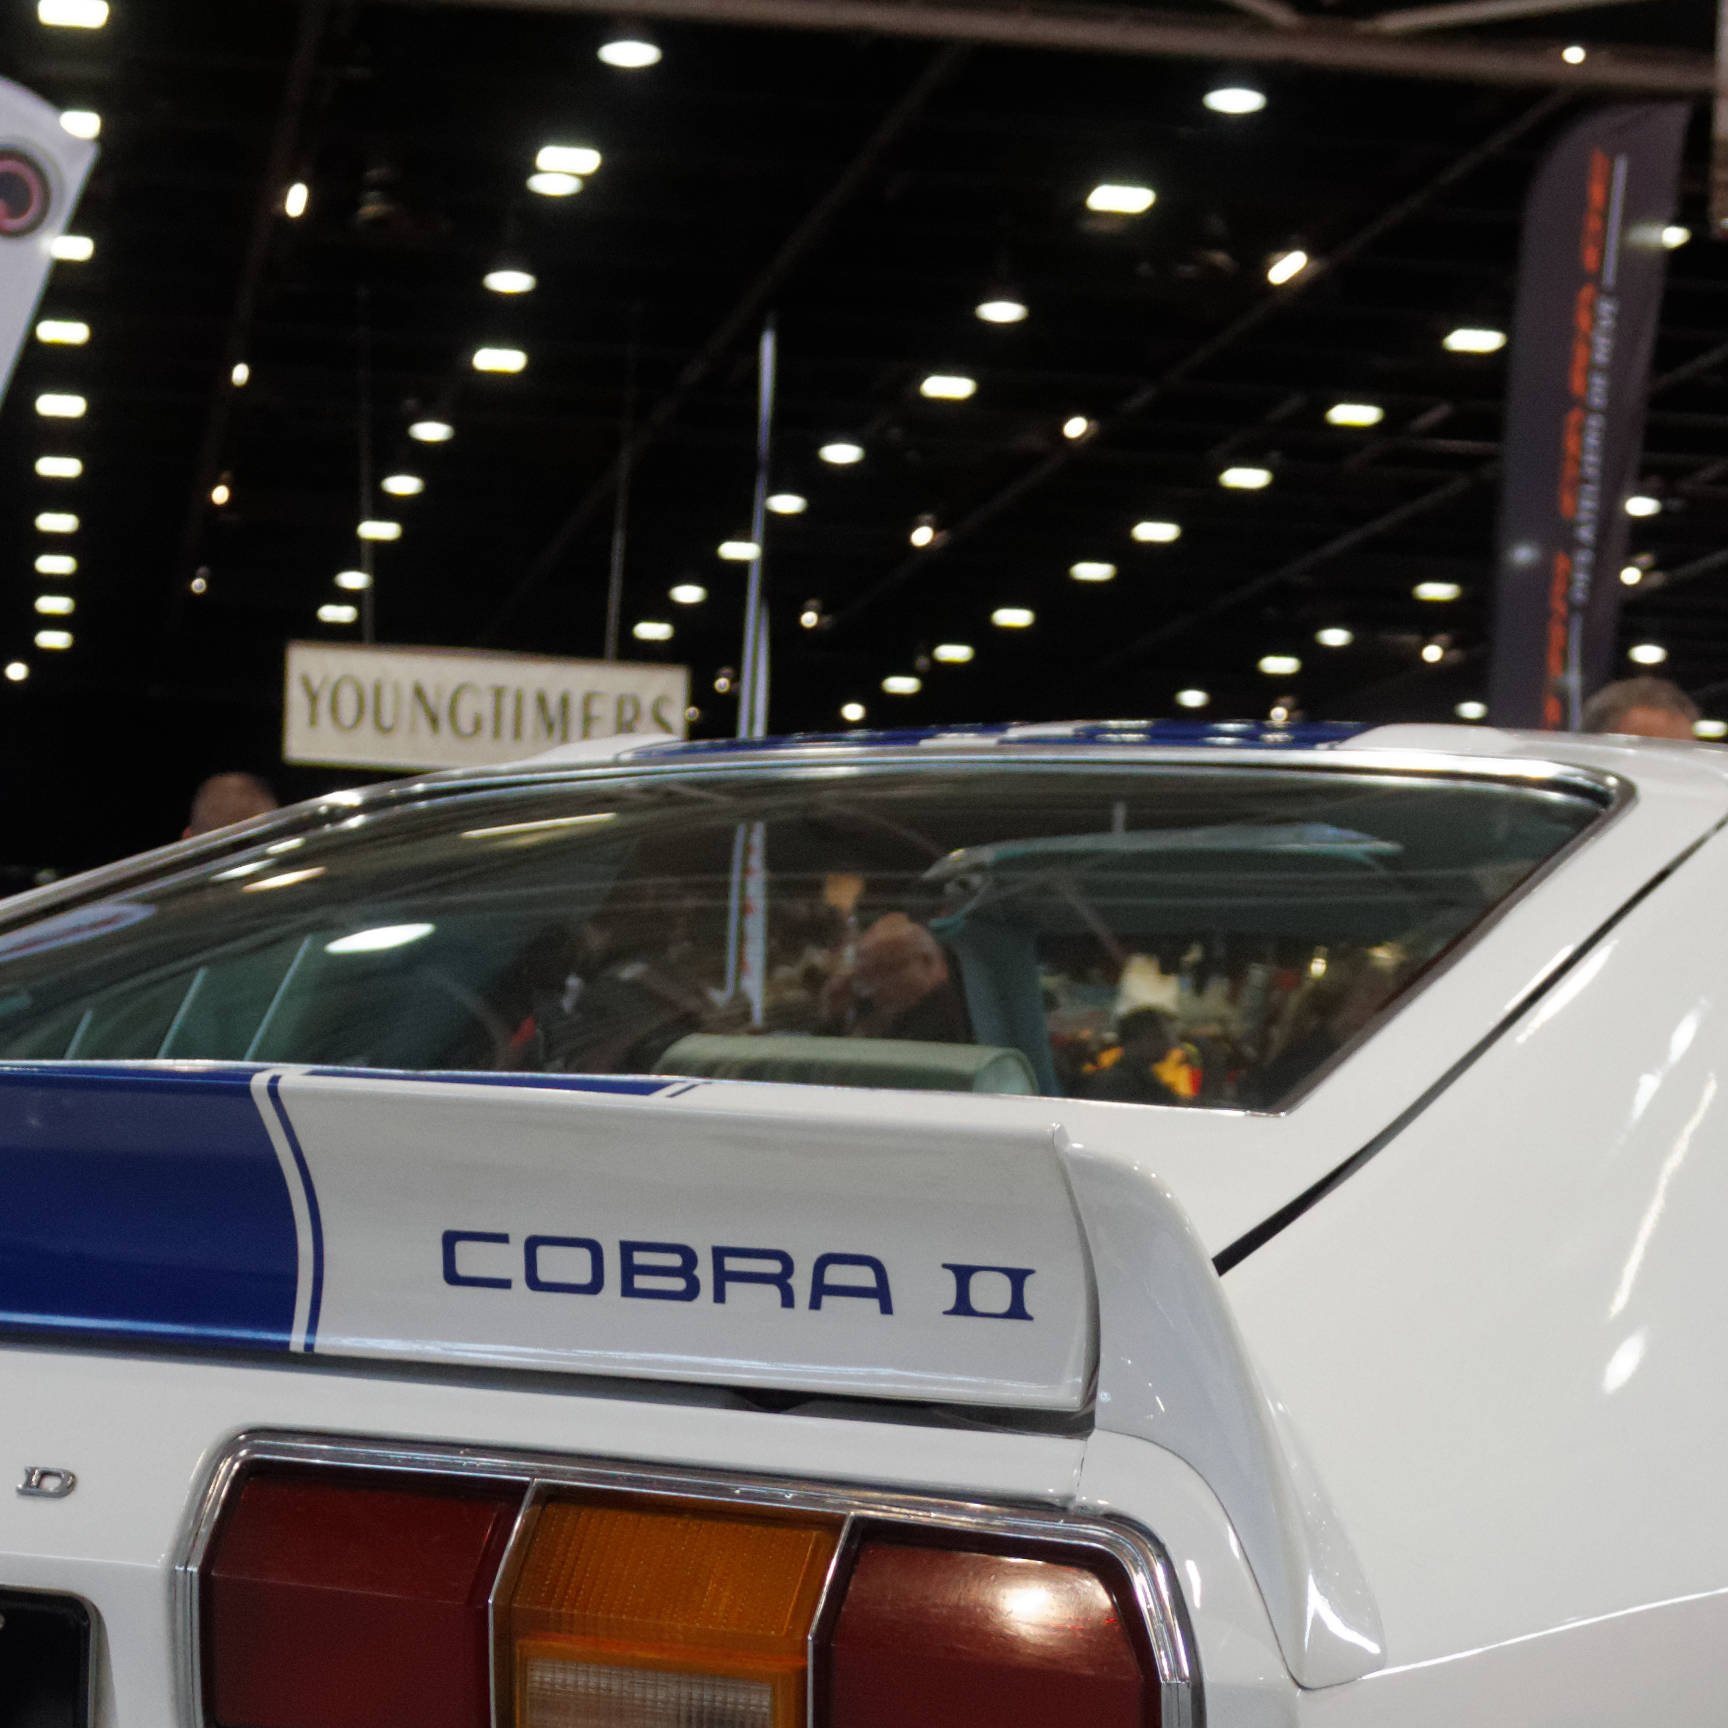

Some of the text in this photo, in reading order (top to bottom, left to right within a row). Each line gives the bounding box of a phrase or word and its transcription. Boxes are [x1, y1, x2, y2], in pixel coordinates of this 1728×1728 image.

[298, 673, 677, 743] YOUNGTIMERS
[440, 1229, 1036, 1321] COBRA II
